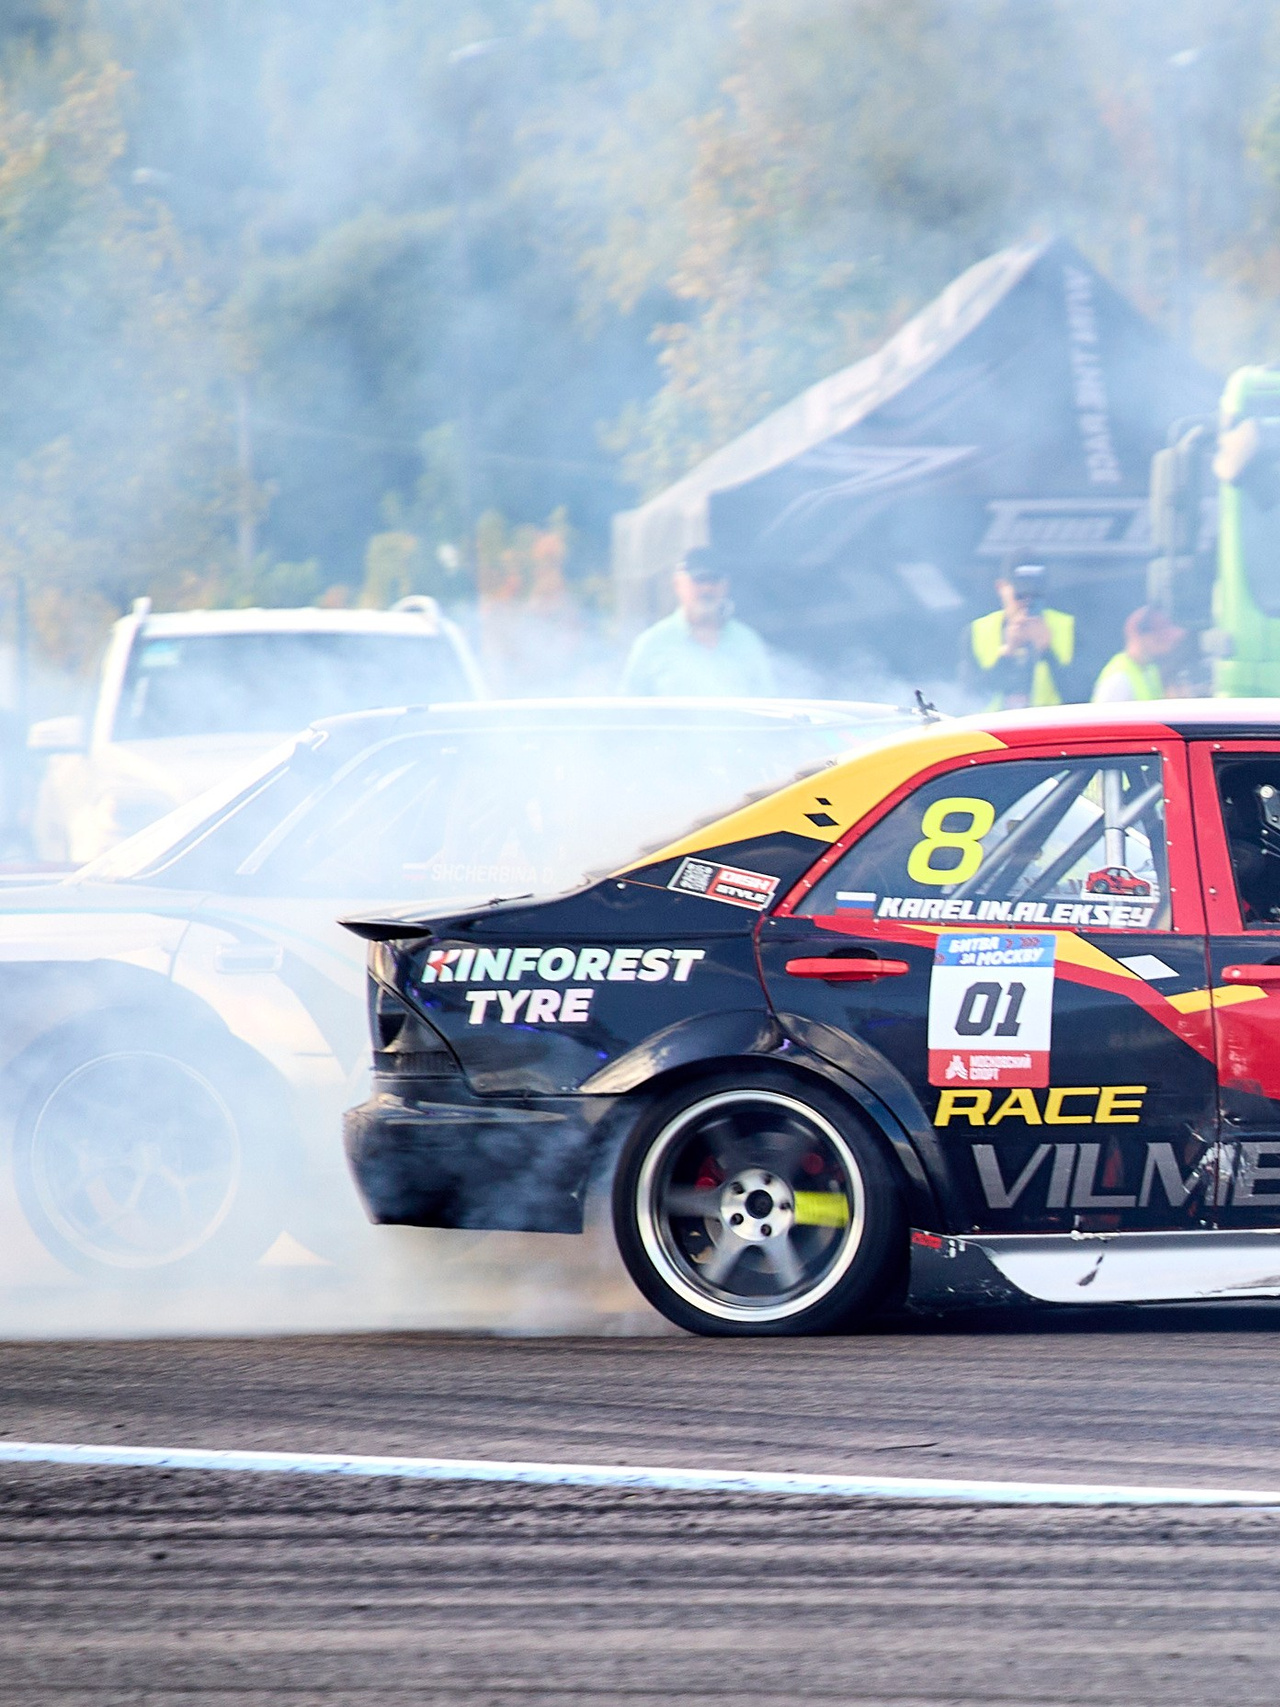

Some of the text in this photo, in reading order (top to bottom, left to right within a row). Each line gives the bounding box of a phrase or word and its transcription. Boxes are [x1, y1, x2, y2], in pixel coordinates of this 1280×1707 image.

[907, 797, 995, 885] 8
[430, 863, 538, 884] SHCHERBINA
[421, 947, 706, 983] KINFOREST
[465, 988, 594, 1025] TYRE
[954, 981, 1026, 1037] 01
[934, 1085, 1148, 1127] RACE
